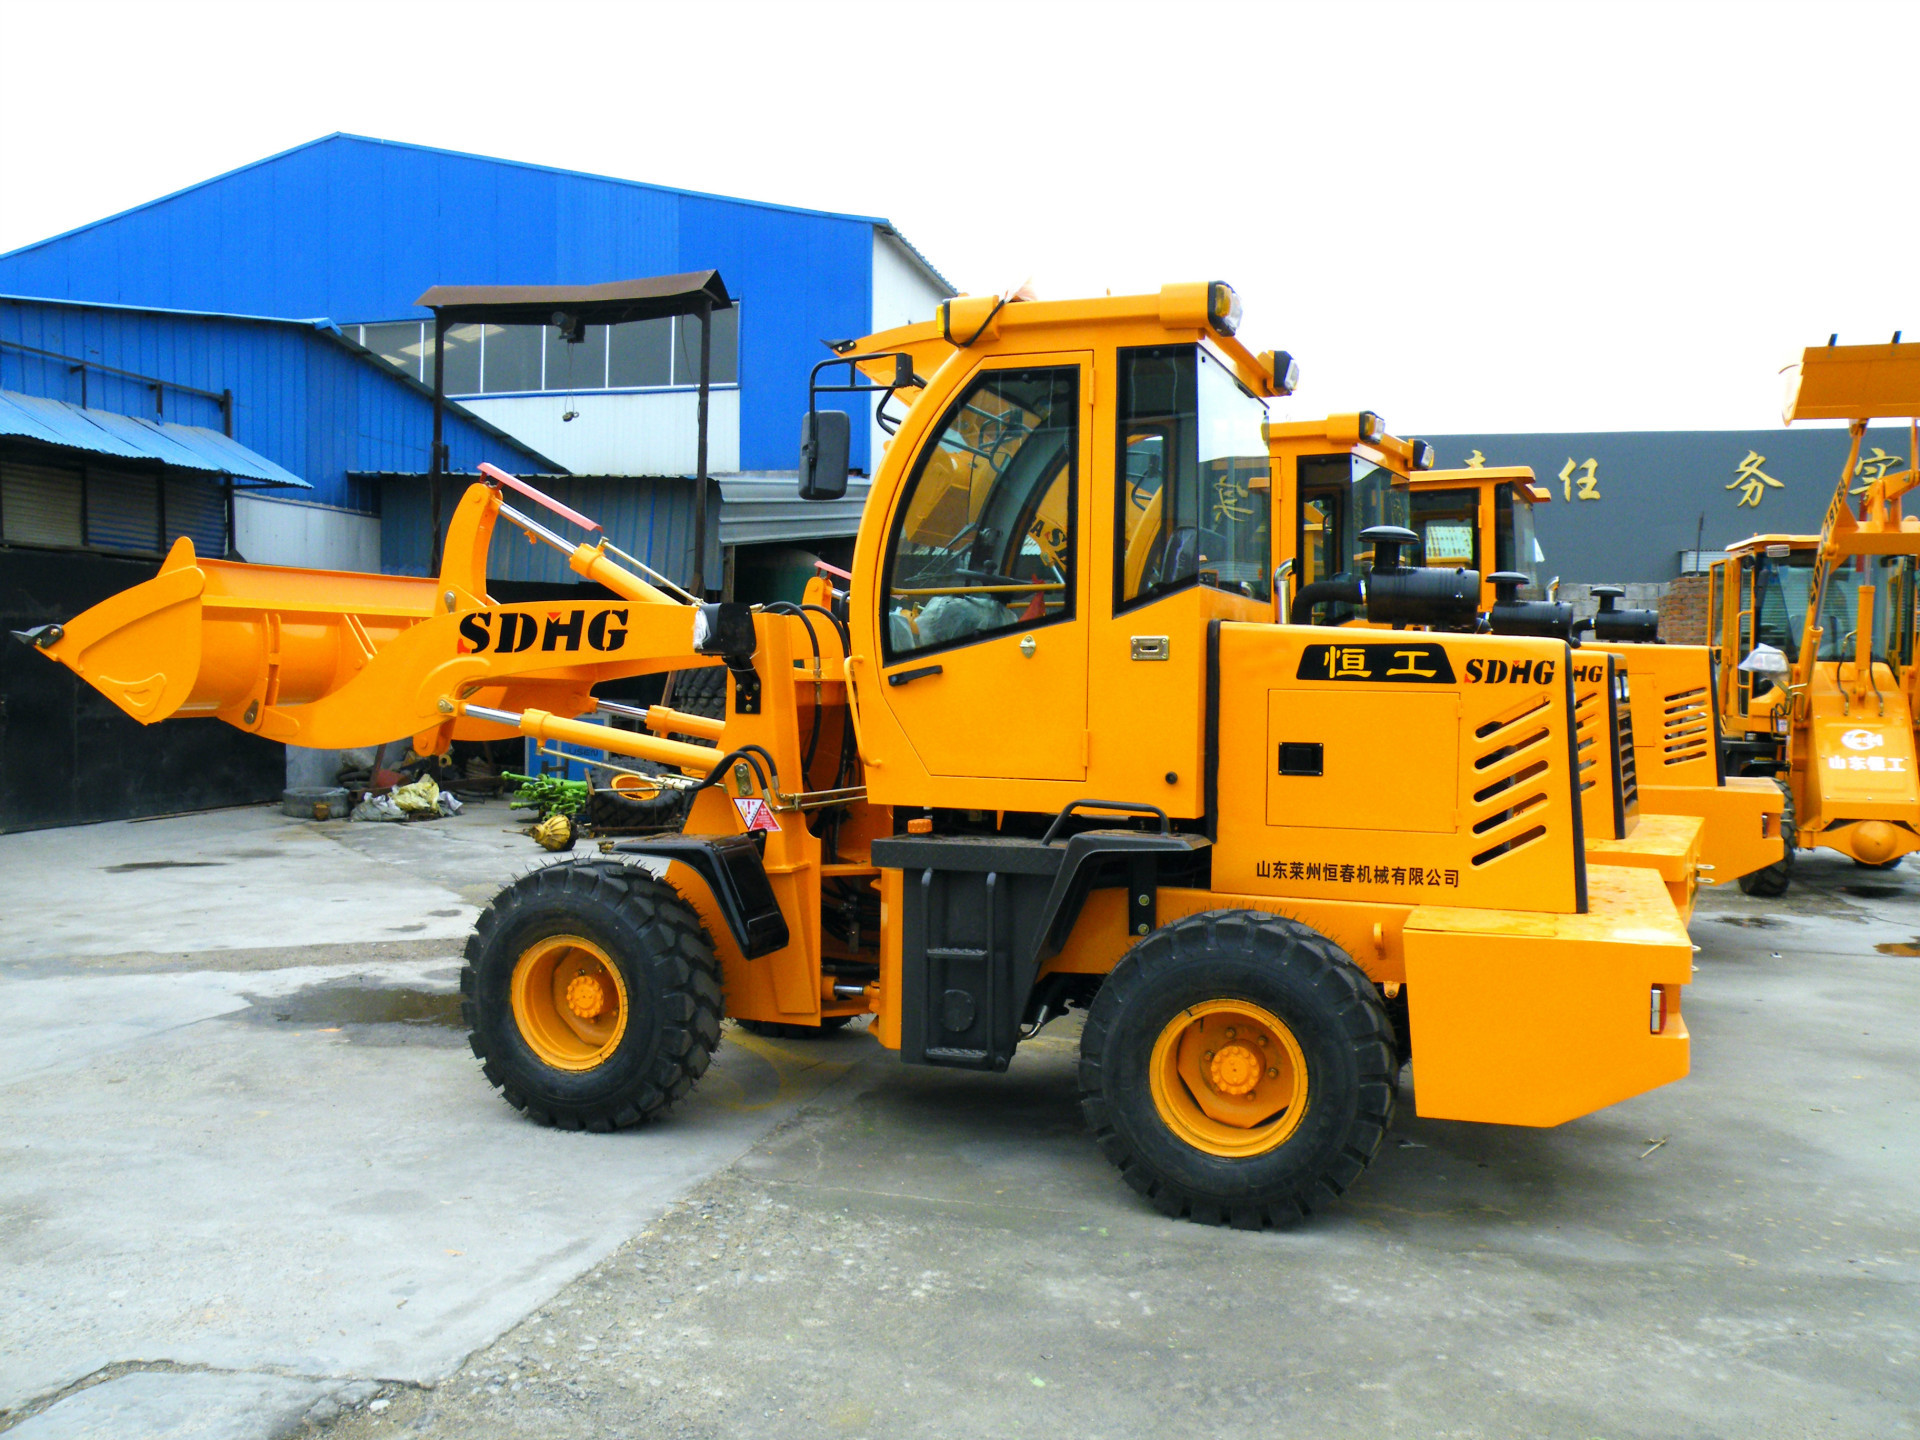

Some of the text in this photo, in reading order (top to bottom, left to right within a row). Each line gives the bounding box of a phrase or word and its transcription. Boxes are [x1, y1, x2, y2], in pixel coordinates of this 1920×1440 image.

[1558, 457, 1601, 502] 任
[1725, 450, 1785, 507] 务
[457, 609, 628, 654] SDHG
[1323, 645, 1437, 679] 恒工
[1463, 658, 1555, 685] SDHG
[1573, 664, 1604, 683] HG
[1256, 860, 1460, 888] 山东莱州恒春机械有限公司
